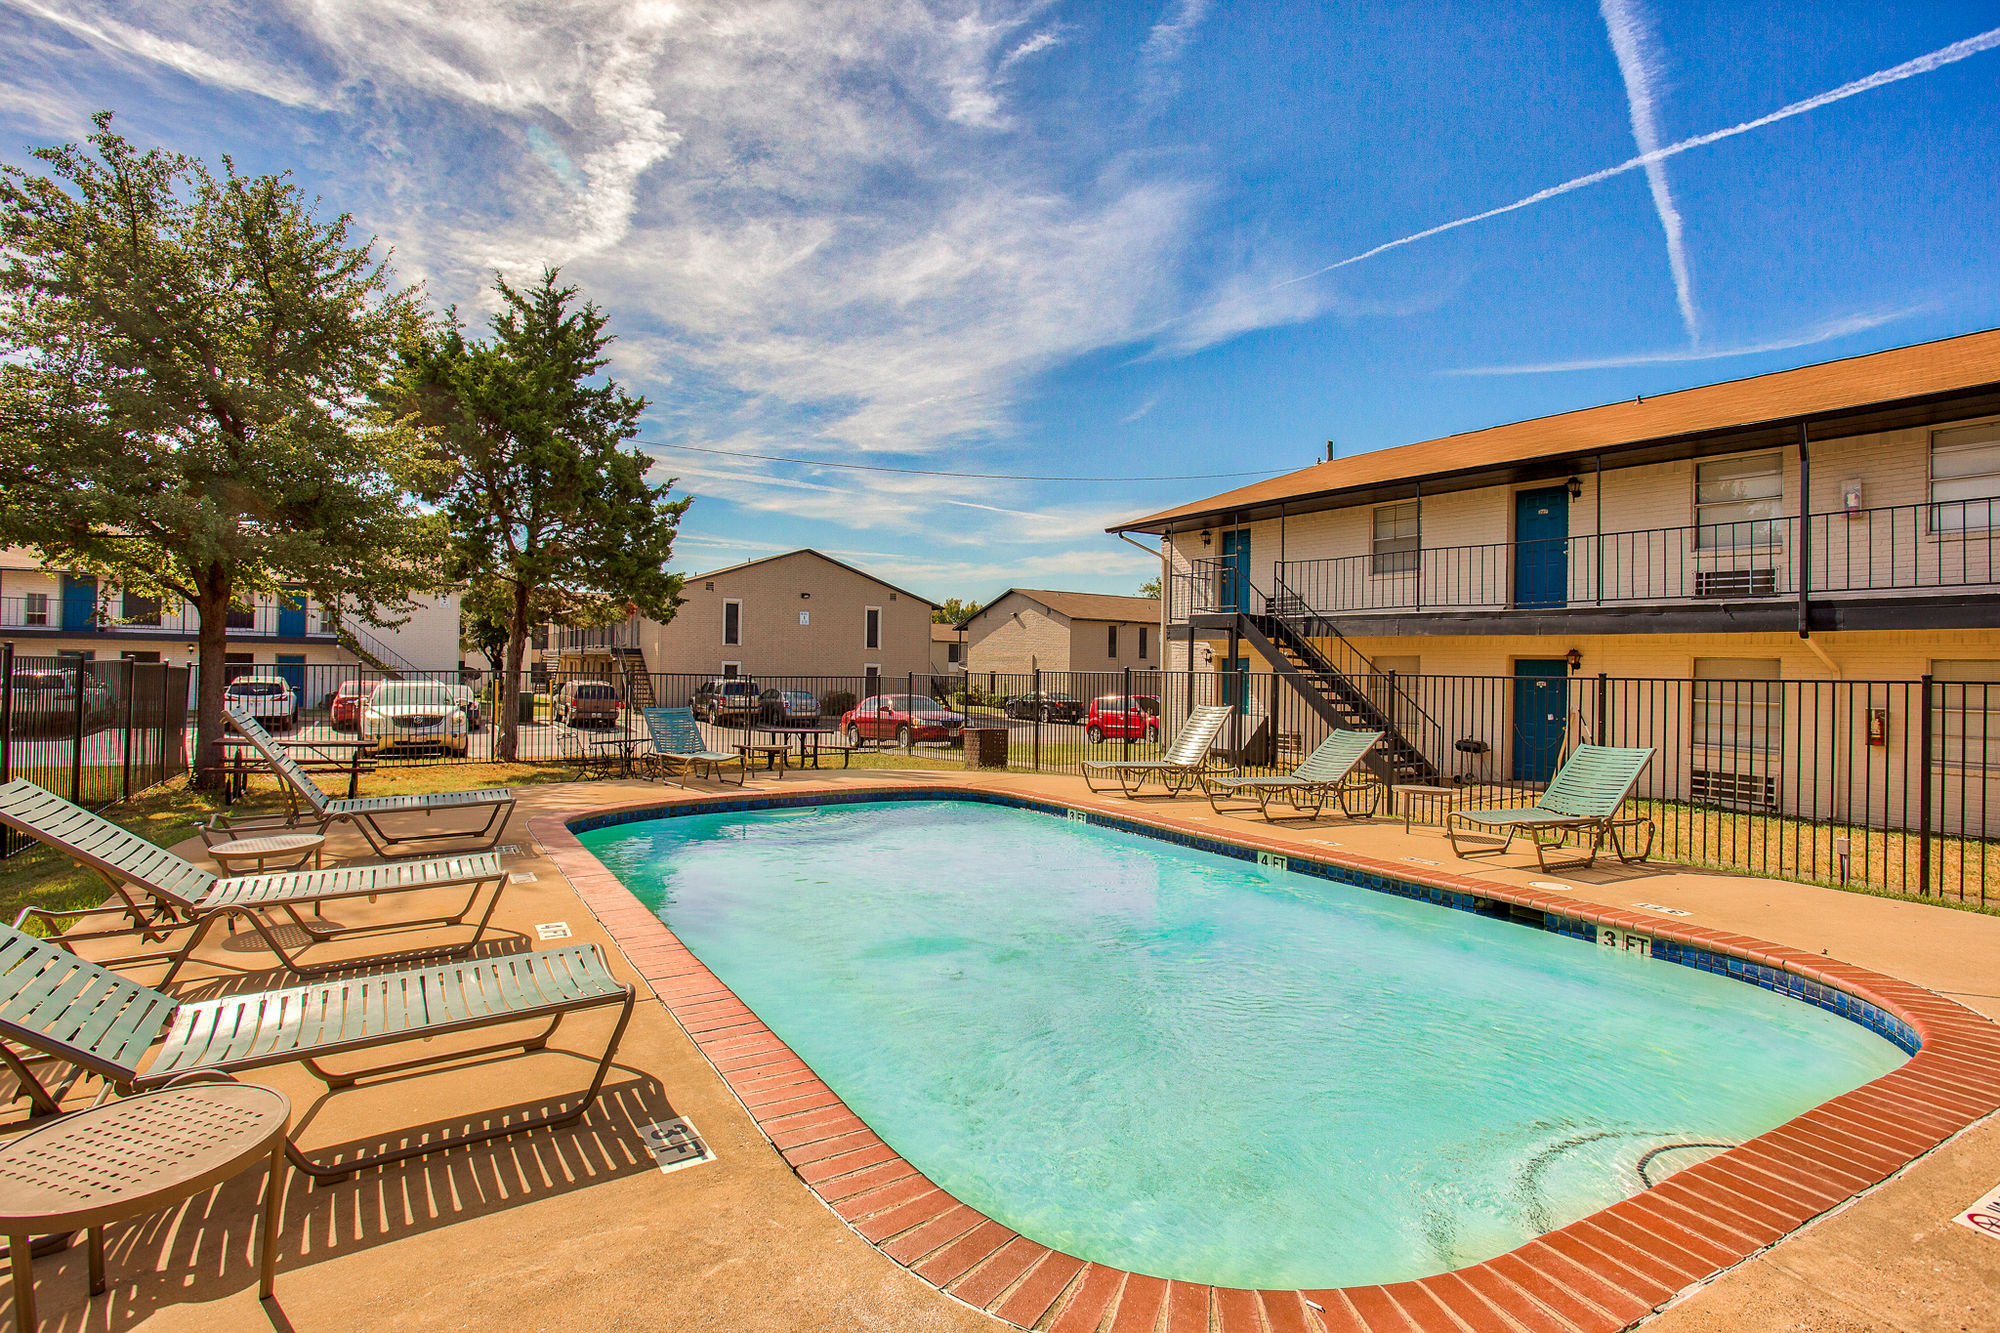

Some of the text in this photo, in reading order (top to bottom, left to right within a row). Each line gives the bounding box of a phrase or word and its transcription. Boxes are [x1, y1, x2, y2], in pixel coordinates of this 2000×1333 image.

[1261, 854, 1286, 870] 4 FT
[1604, 930, 1649, 954] 3 FT
[650, 1123, 707, 1166] 3 FT
